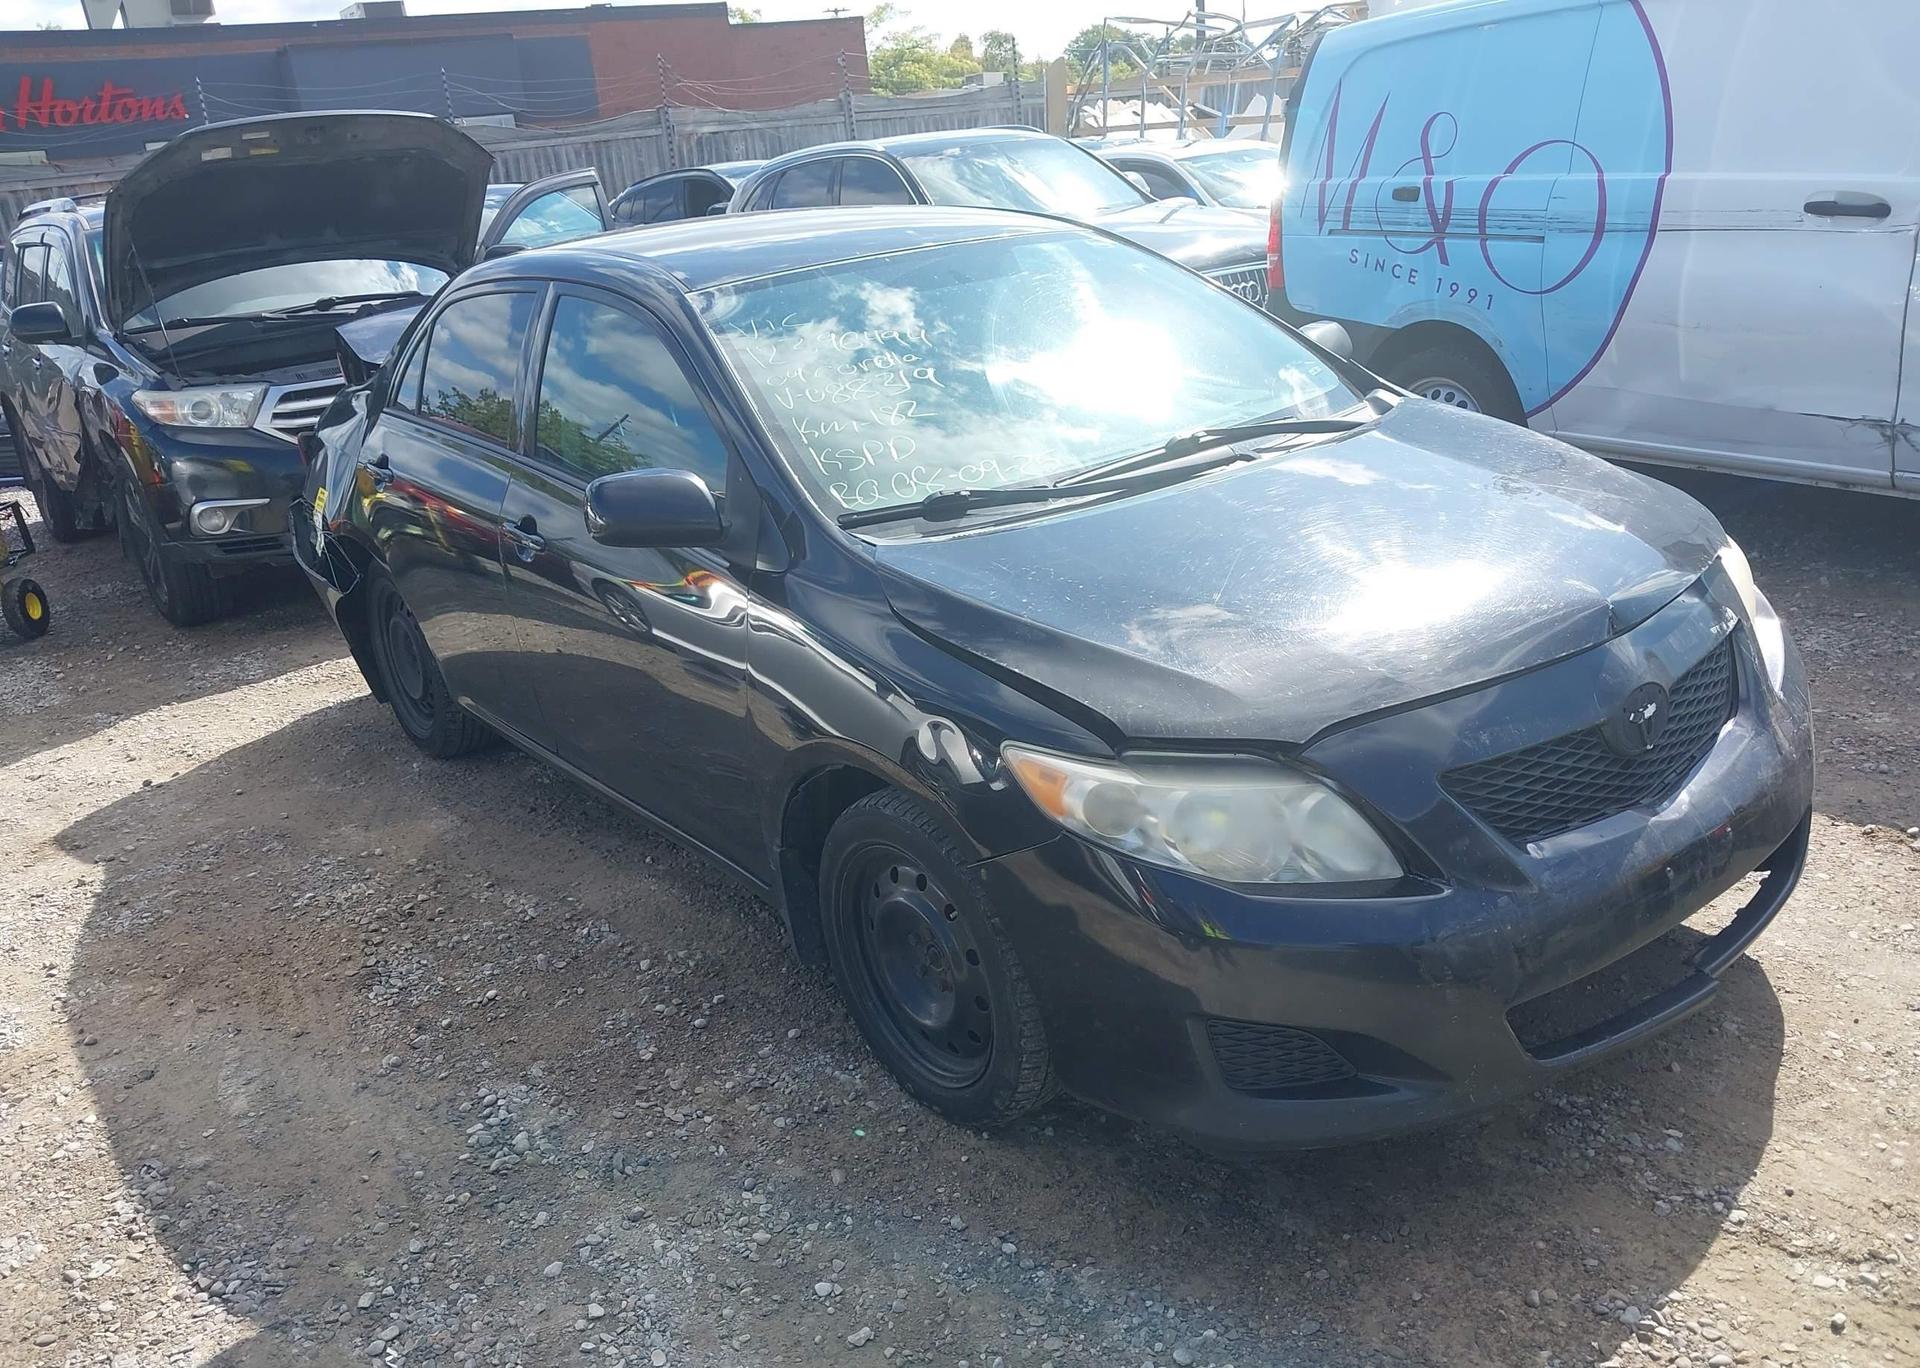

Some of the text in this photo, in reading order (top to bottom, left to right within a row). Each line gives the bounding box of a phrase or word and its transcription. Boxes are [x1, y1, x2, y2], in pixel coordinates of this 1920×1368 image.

[15, 74, 190, 129] Hortons
[1349, 248, 1493, 310] SINCE 1991
